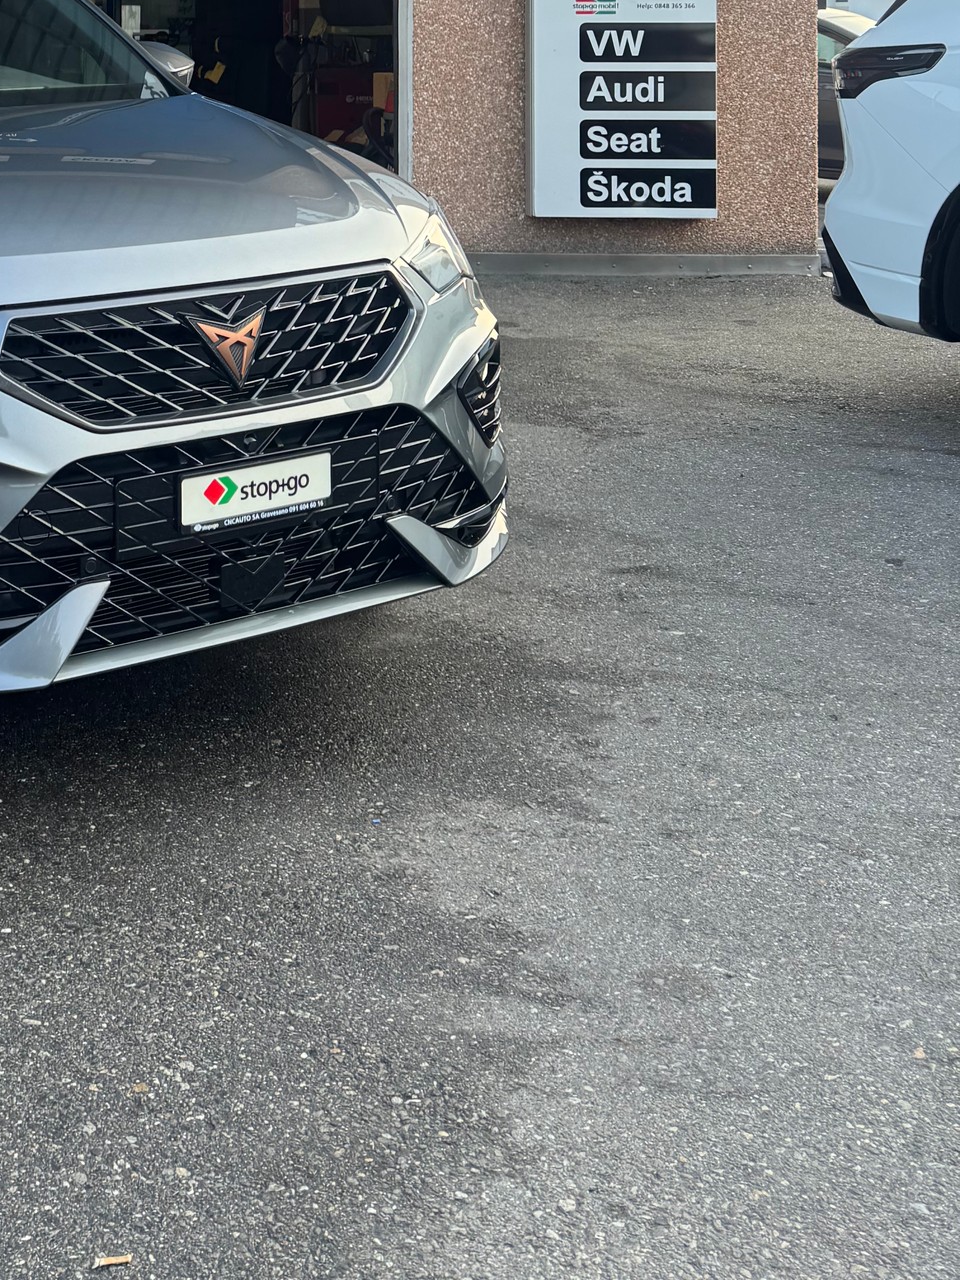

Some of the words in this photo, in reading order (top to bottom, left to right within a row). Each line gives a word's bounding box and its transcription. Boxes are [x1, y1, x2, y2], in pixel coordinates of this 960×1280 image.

[586, 29, 645, 57] VW
[586, 76, 665, 102] Audi
[586, 125, 662, 153] Seat
[587, 171, 693, 203] Škoda
[240, 473, 310, 500] stop+go
[224, 515, 252, 526] CNCAUTO
[251, 512, 260, 521] SA
[260, 506, 289, 519] Gravesano
[289, 505, 299, 513] 091
